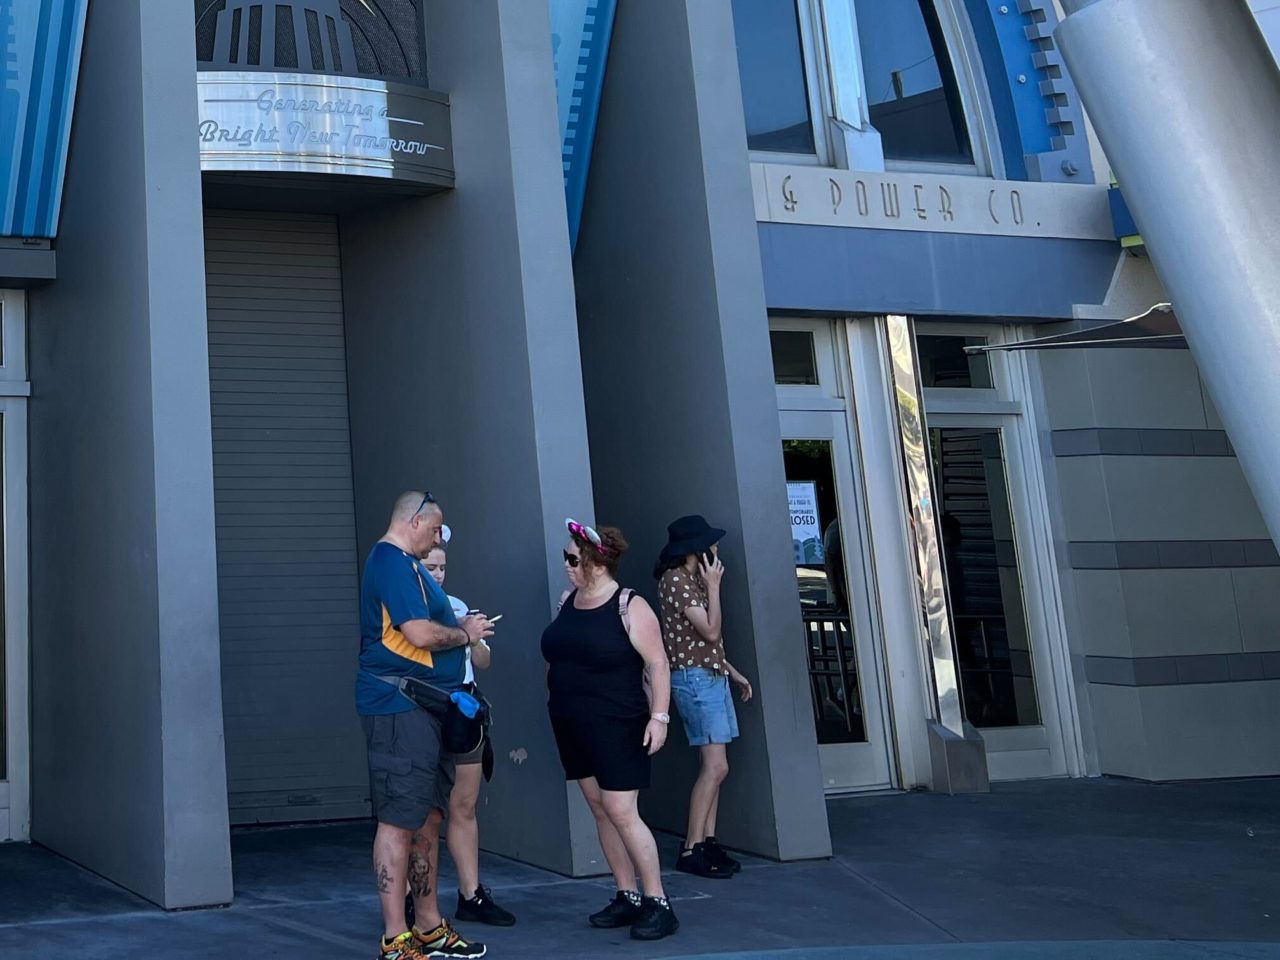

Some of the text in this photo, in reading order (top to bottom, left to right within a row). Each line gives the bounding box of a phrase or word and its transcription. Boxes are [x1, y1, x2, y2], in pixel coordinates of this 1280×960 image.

[256, 89, 374, 121] Generating
[199, 120, 429, 155] Bright New Tomorrow
[781, 175, 1041, 227] & POWER CO.
[790, 515, 815, 525] LOSED
